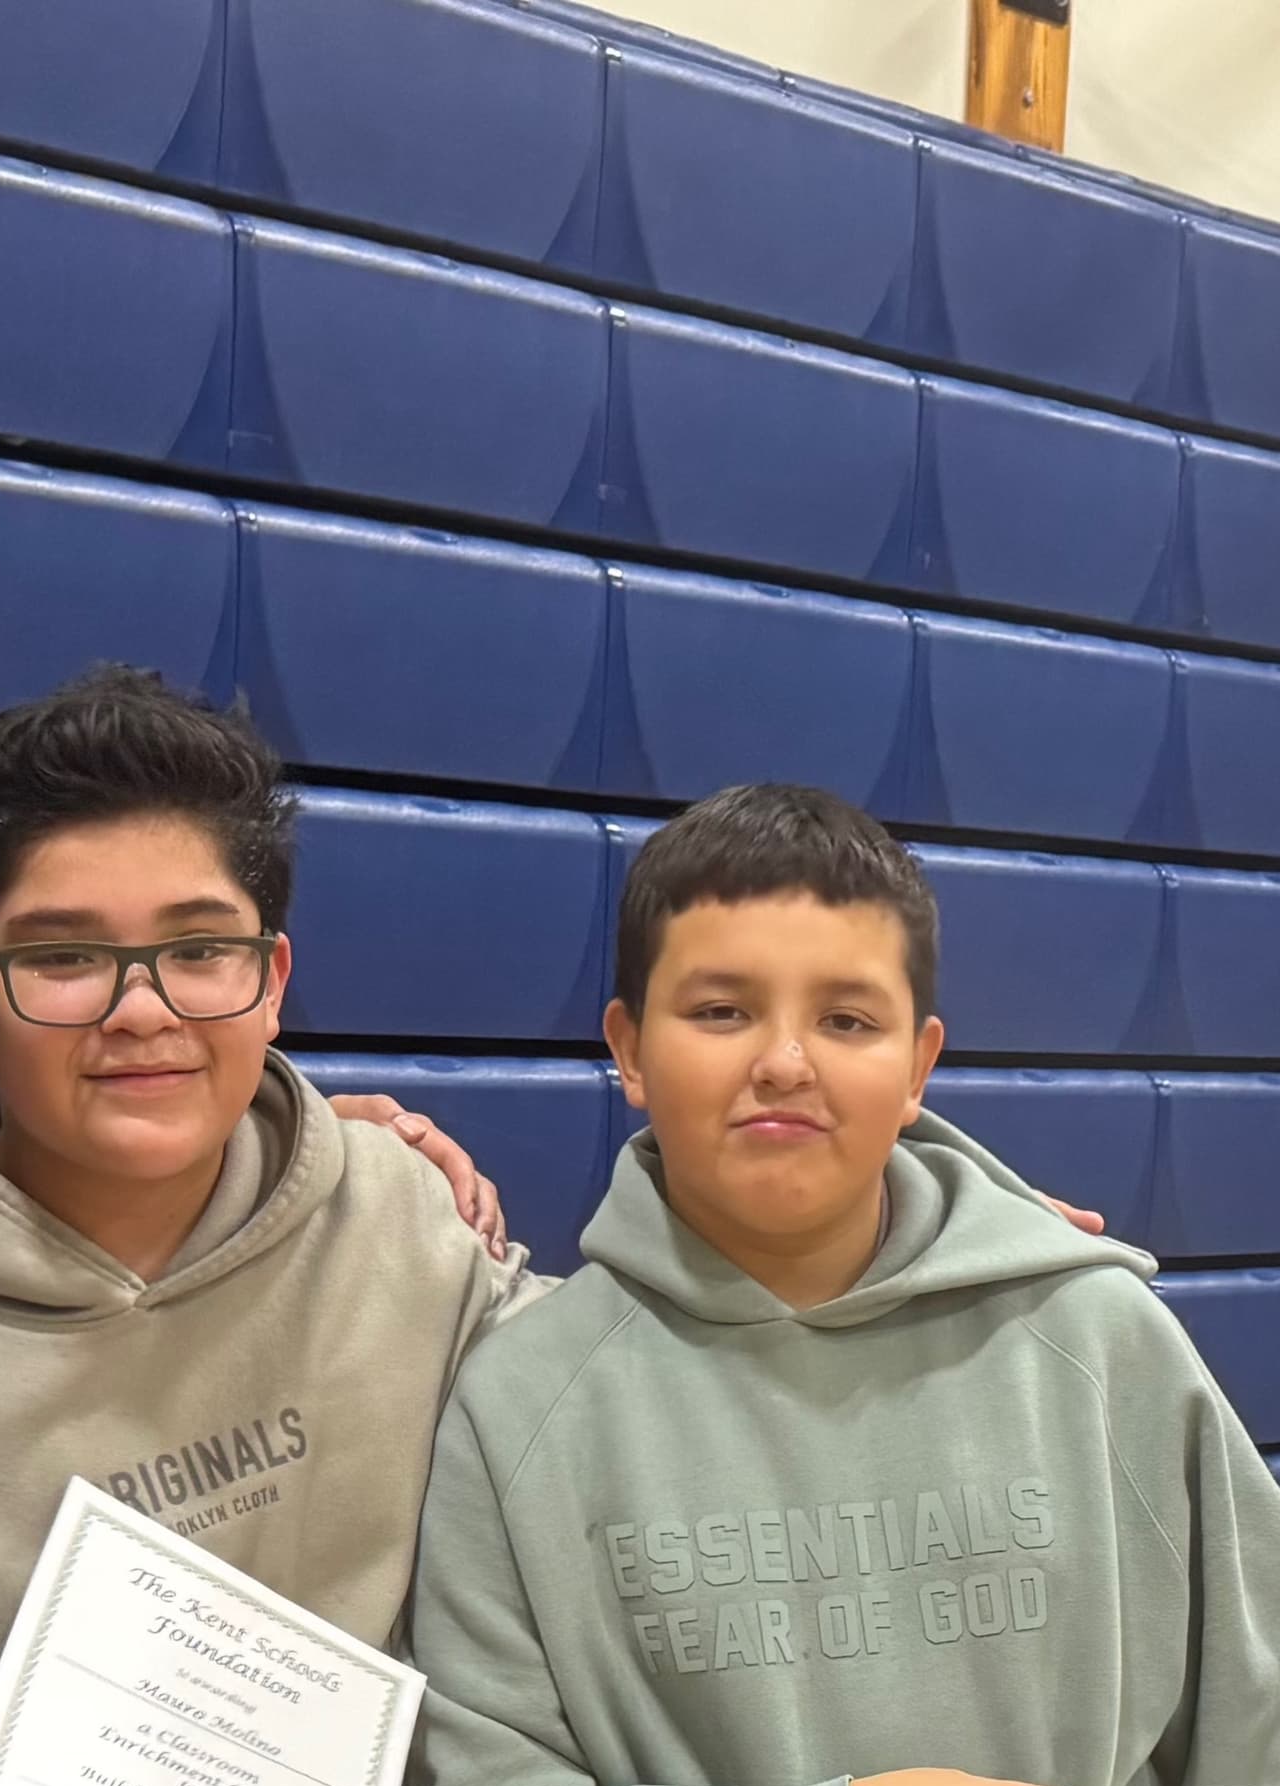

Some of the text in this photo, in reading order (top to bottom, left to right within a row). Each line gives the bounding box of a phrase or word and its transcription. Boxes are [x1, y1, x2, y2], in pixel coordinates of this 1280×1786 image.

[94, 1406, 308, 1518] RIGINALS
[234, 1484, 281, 1516] CLOTH
[605, 1476, 1056, 1599] ESSENTIALS
[129, 1568, 343, 1693] The Kent Schools
[147, 1615, 302, 1705] Foundation
[633, 1566, 1048, 1675] FEAR OF GOD
[135, 1678, 208, 1720] Mauro
[137, 1723, 260, 1784] a Classroom
